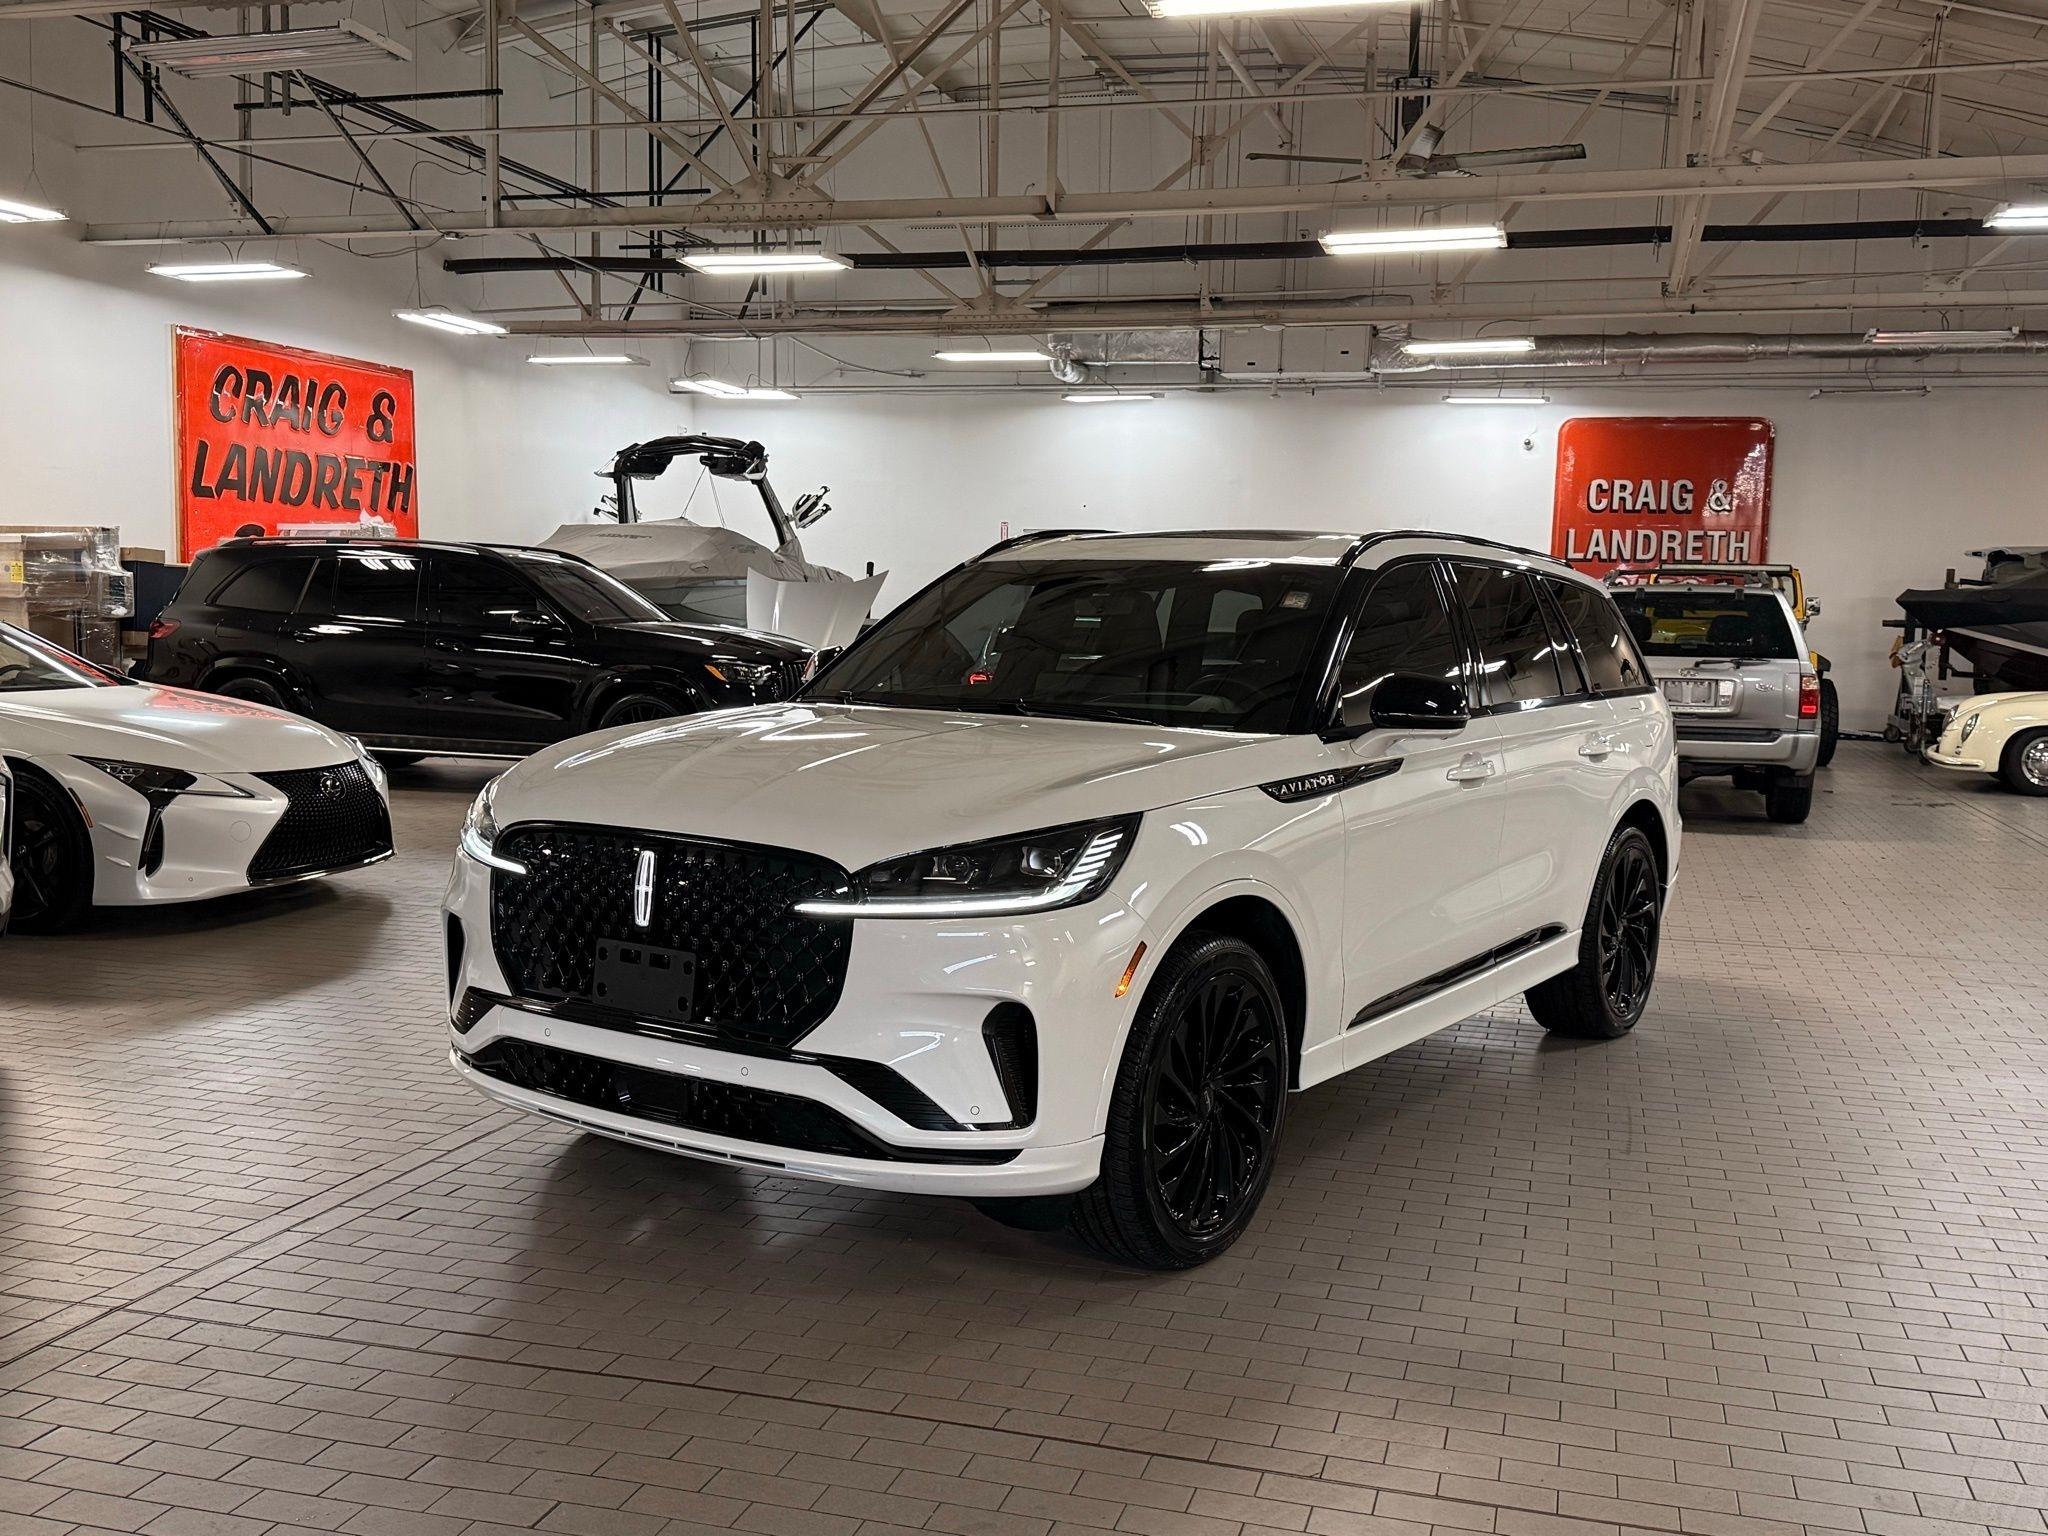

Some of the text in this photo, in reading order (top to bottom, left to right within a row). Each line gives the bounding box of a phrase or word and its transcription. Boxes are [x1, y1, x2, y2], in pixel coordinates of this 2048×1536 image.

[209, 364, 396, 444] CRAIG &
[191, 439, 414, 514] LANDRETH
[1587, 478, 1733, 514] CRAIG &
[1566, 528, 1750, 564] LANDRETH
[1280, 774, 1336, 795] AVIATOR
